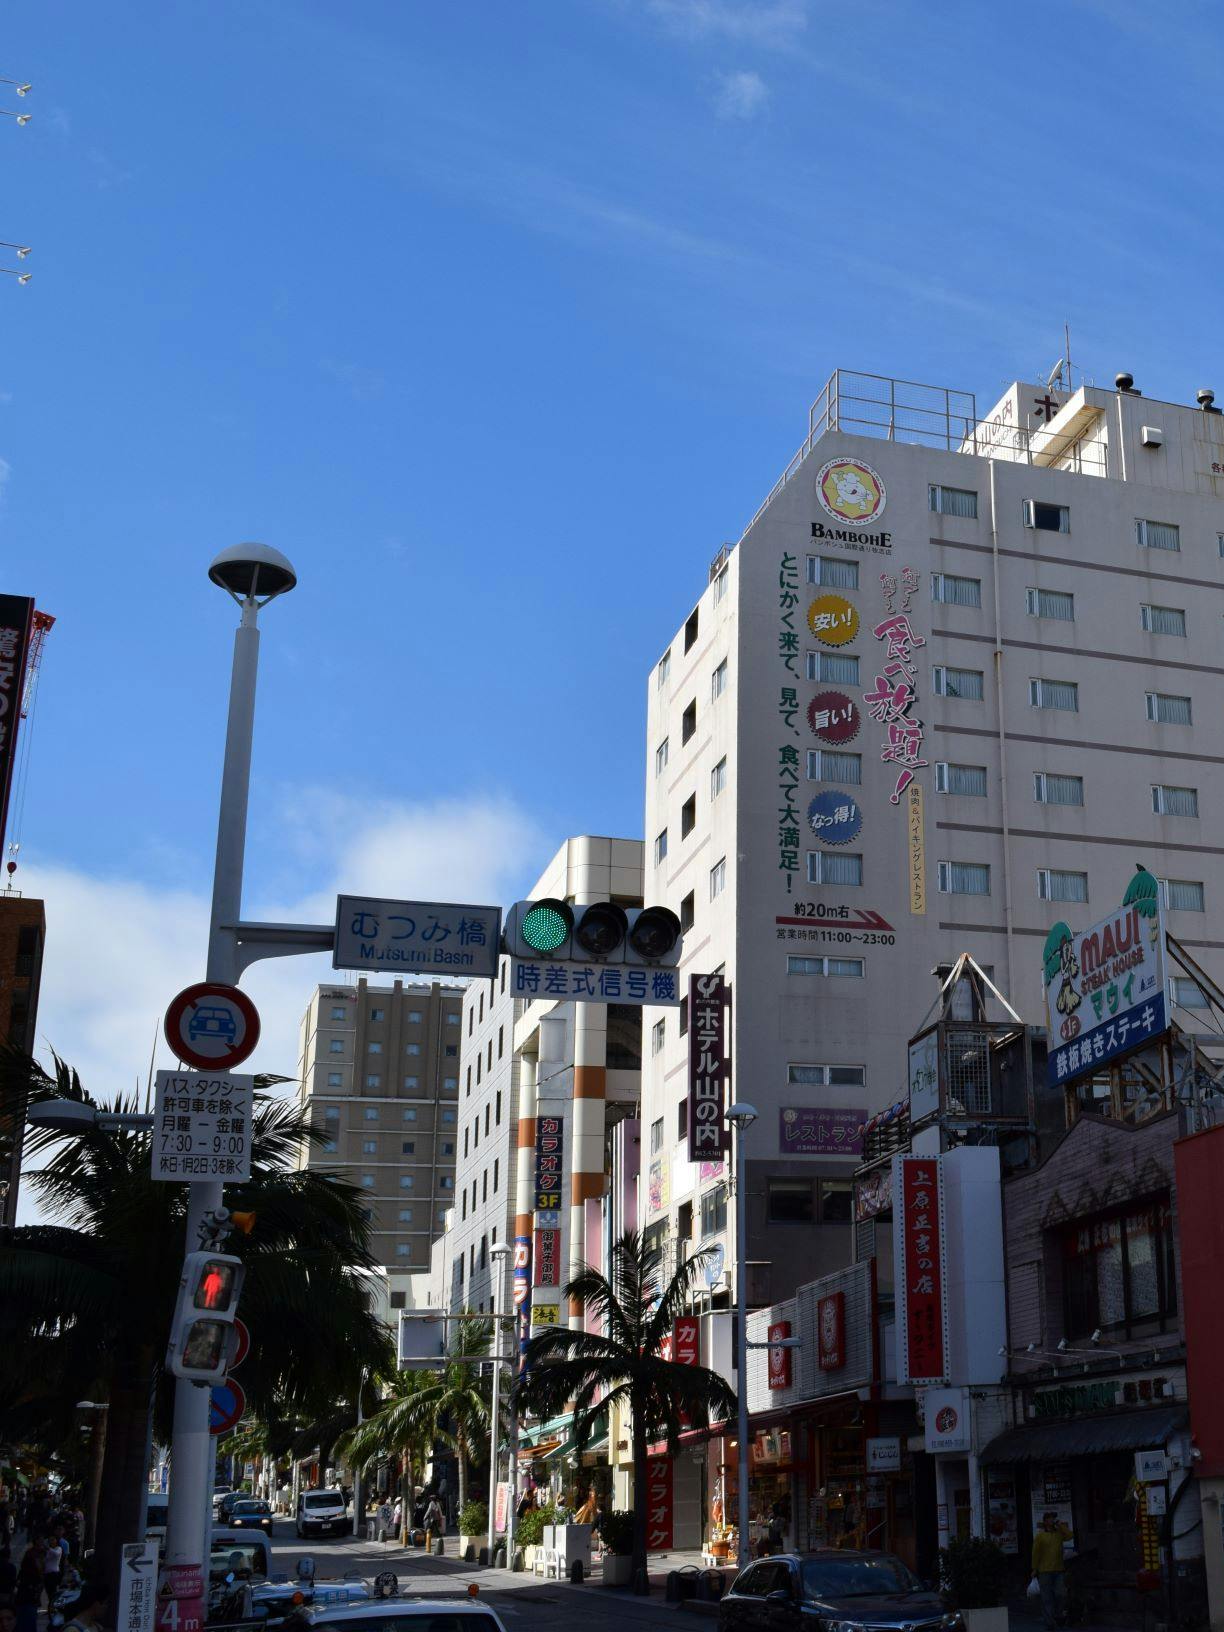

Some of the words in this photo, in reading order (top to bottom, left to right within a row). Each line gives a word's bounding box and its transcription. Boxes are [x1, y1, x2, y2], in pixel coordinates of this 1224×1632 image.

[811, 522, 892, 548] BAMBOHE
[351, 911, 486, 947] むつみ橋
[793, 903, 850, 920] 約20m右
[360, 944, 432, 963] Mutsumi
[434, 948, 474, 966] Bashi
[1080, 909, 1140, 976] MAUI
[516, 963, 676, 1000] 時差式信号機
[1080, 967, 1110, 994] STEAK
[1112, 946, 1144, 977] HOUSE
[1090, 972, 1136, 1021] マウイ
[1056, 1005, 1156, 1080] 鉄板焼きステーキ
[695, 1007, 720, 1147] ホテル山の内
[163, 1096, 246, 1115] 許可車を除く
[162, 1115, 191, 1132] 月曜
[216, 1117, 244, 1134] 金曜
[785, 1124, 863, 1143] レストラン
[161, 1134, 192, 1152] 7:30
[213, 1136, 244, 1154] 9:00
[539, 1118, 558, 1190] カラオケ
[538, 1194, 559, 1208] 3F
[541, 1231, 555, 1286] 御菓子御殿
[650, 1461, 670, 1549] カラオケ
[160, 1600, 181, 1632] 4
